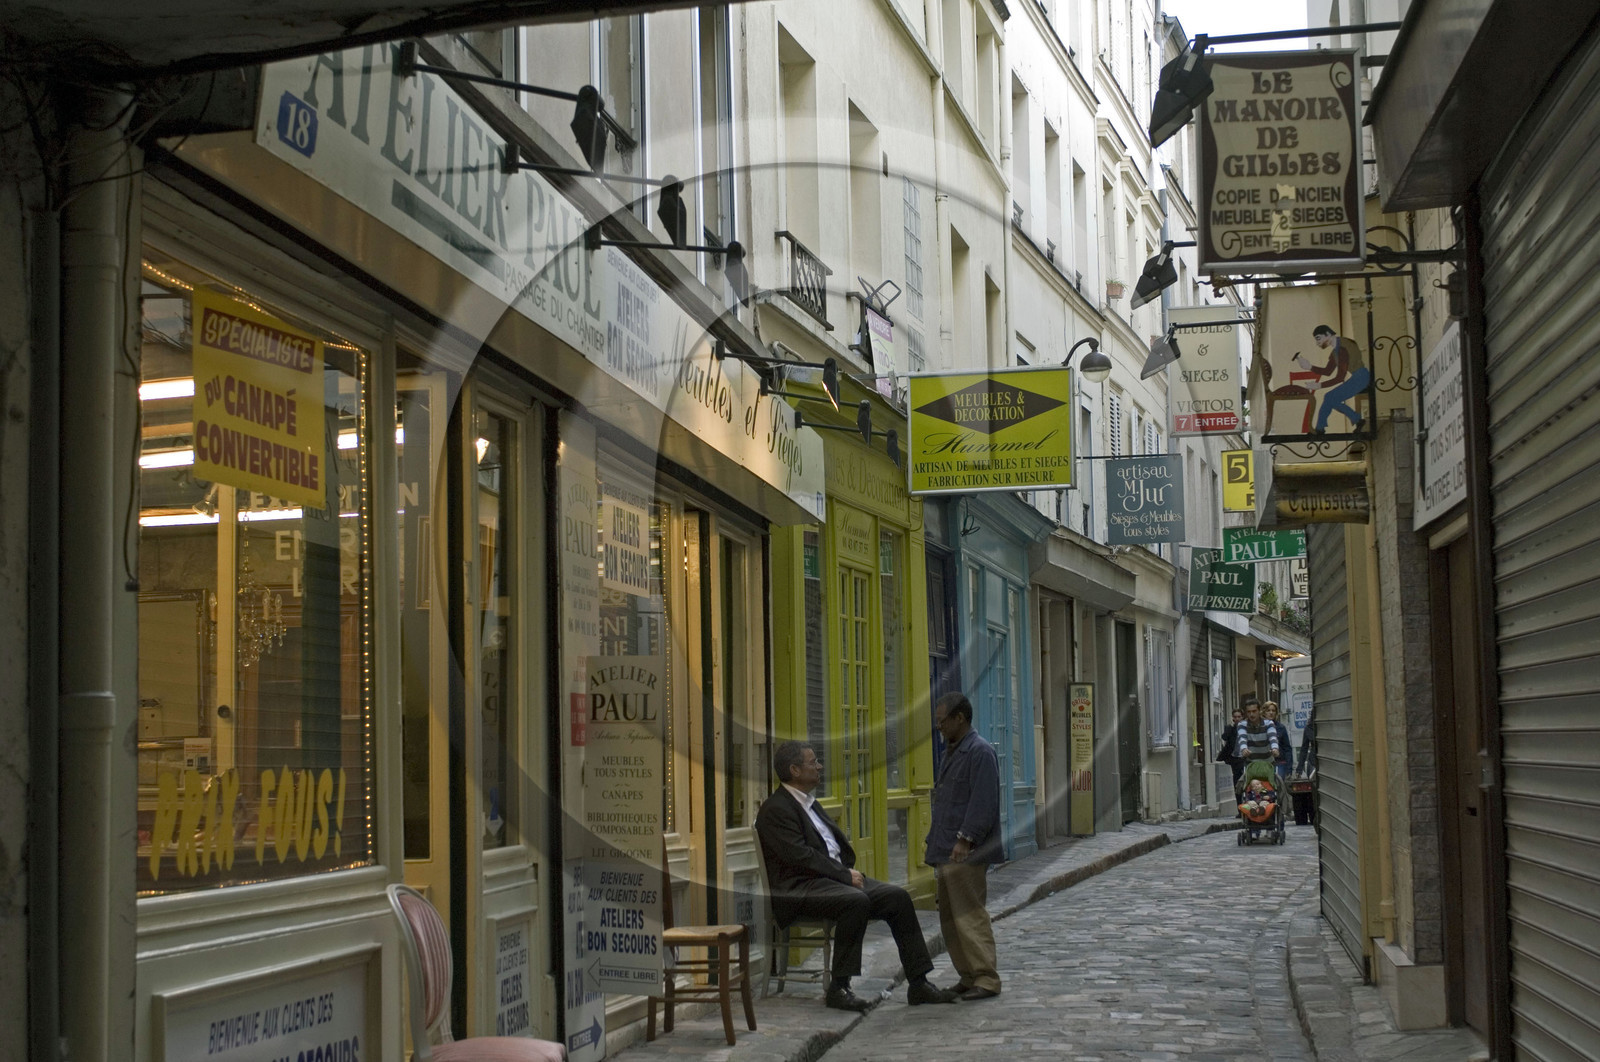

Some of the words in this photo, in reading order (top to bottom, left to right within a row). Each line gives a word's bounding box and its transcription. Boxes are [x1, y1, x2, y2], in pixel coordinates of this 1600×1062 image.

[1252, 71, 1293, 94] LE
[1213, 97, 1342, 123] MANOIR
[285, 103, 311, 149] 18
[1256, 126, 1299, 149] DE
[1222, 152, 1341, 177] GILLES
[303, 38, 509, 253] ATELIER
[524, 170, 601, 322] PAUL
[1216, 189, 1261, 205] COPIE
[1212, 208, 1282, 225] MEUBLE
[1292, 207, 1344, 222] SIEGES
[1244, 233, 1300, 248] ENTE
[1310, 232, 1352, 246] LIBRE
[504, 263, 547, 313] PASSAGE
[551, 295, 563, 323] DU
[566, 308, 605, 347] CHANTIER
[616, 281, 650, 346] ATELIERS
[204, 313, 312, 372] SPÉCIALISTE
[1197, 344, 1209, 356] &
[607, 320, 624, 373] BON
[626, 335, 658, 398] SECOURS
[661, 315, 733, 424] Meubles
[745, 387, 760, 440] et
[1179, 369, 1229, 383] SIEGES
[204, 375, 221, 408] DU
[223, 376, 297, 436] CANAPÉ
[954, 392, 1012, 408] MEUBLES
[1017, 391, 1025, 405] &
[1177, 399, 1234, 412] VICTOR
[954, 405, 1025, 423] DECORATION
[1179, 418, 1187, 429] 7
[1195, 416, 1237, 427] ENTREE
[922, 429, 1059, 455] Hummel
[196, 419, 319, 490] CONVERTIBLE
[913, 461, 953, 474] ARTISAN
[956, 460, 969, 472] DE
[972, 457, 1018, 471] MEUBLES
[1020, 457, 1032, 468] ET
[1035, 455, 1069, 468] SIEGES
[847, 453, 856, 491] &
[928, 473, 989, 487] FABRICATION
[992, 472, 1011, 484] SUR
[1015, 470, 1055, 483] MESURE
[1117, 465, 1173, 480] artisan
[1228, 457, 1246, 482] 5
[1426, 470, 1451, 511] ENTREE
[1288, 490, 1359, 516] Tapissier
[612, 505, 640, 549] ATELIERS
[1146, 510, 1183, 526] Meubles
[563, 515, 597, 560] PAUL
[1123, 526, 1143, 537] tous
[1144, 524, 1170, 540] styles
[1230, 540, 1284, 561] PAUL
[604, 543, 618, 582] BON
[620, 547, 648, 590] SECOURS
[1200, 573, 1243, 586] PAUL
[1190, 594, 1251, 610] TAPISSIER
[590, 665, 658, 691] ATELIER
[589, 692, 657, 722] PAUL
[602, 755, 645, 766] MEUBLES
[594, 767, 618, 778] TOUS
[619, 768, 653, 779] STYLES
[602, 790, 644, 801] CANAPES
[255, 764, 347, 868] FOUS!
[587, 812, 658, 824] BIBLIOTHEQUES
[590, 825, 654, 836] COMPOSABLES
[592, 847, 607, 859] LIT
[609, 848, 653, 860] GIGOGNE
[600, 871, 644, 887] BIENVENUE
[588, 888, 603, 901] AUX
[605, 888, 639, 903] CLIENTS
[640, 891, 657, 904] DES
[600, 908, 644, 930] ATELIERS
[587, 931, 607, 953] BON
[612, 933, 658, 956] SECOURS
[600, 968, 630, 980] ENTREE
[633, 970, 657, 982] LIBRE
[208, 1011, 261, 1055] BIENVENUE
[262, 1006, 281, 1041] AUX
[281, 997, 316, 1036] CLIENTS
[317, 992, 334, 1025] DES
[572, 1030, 592, 1048] ENTREE
